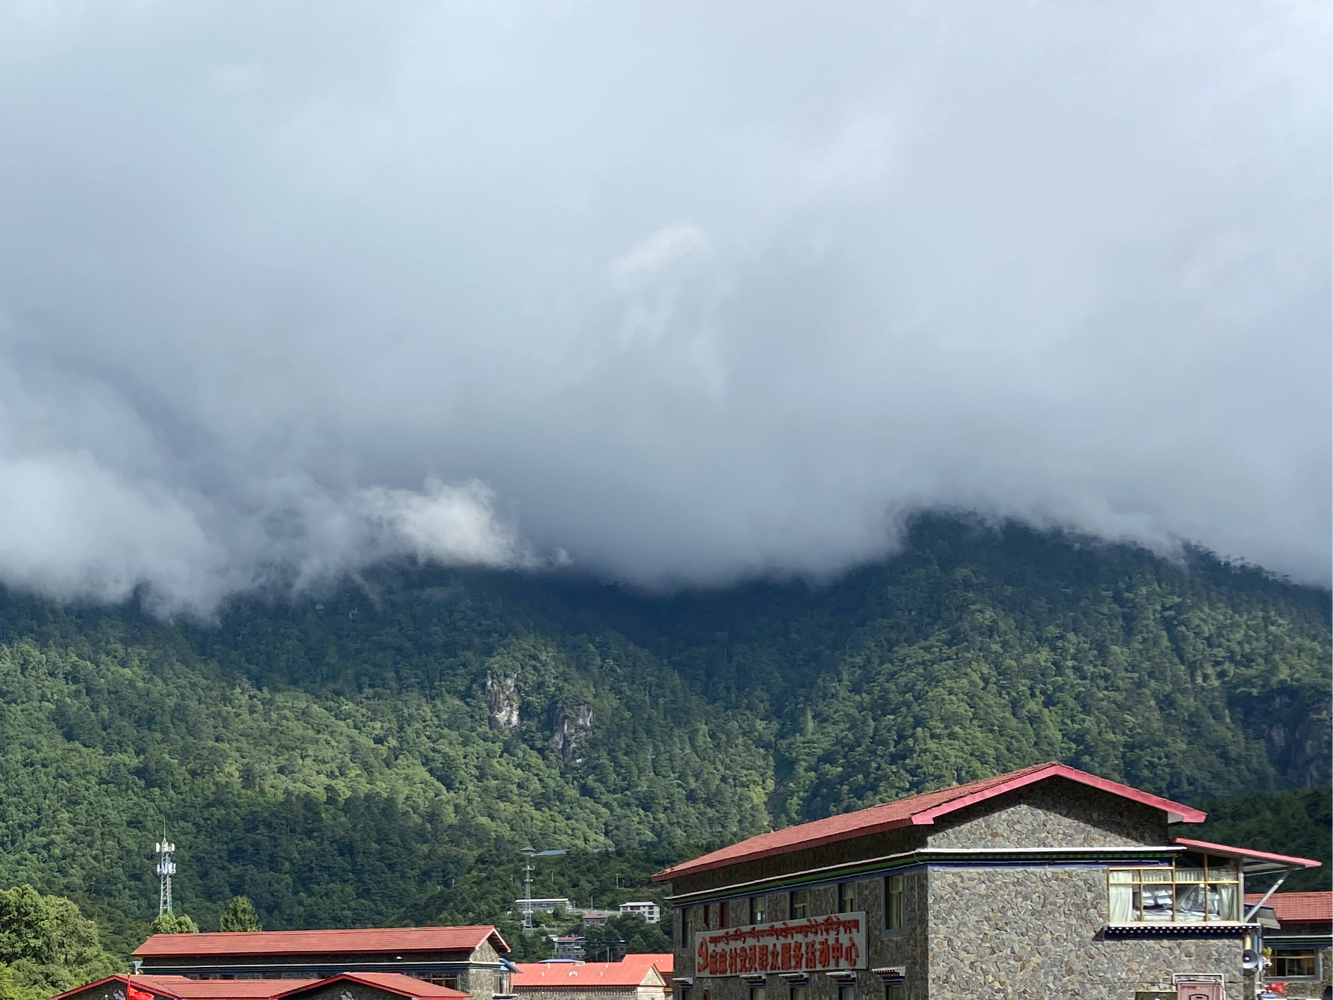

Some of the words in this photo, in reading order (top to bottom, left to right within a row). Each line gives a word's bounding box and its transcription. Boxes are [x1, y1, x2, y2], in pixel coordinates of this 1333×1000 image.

[709, 937, 860, 975] 麻麻村党员群众服务活动中心
